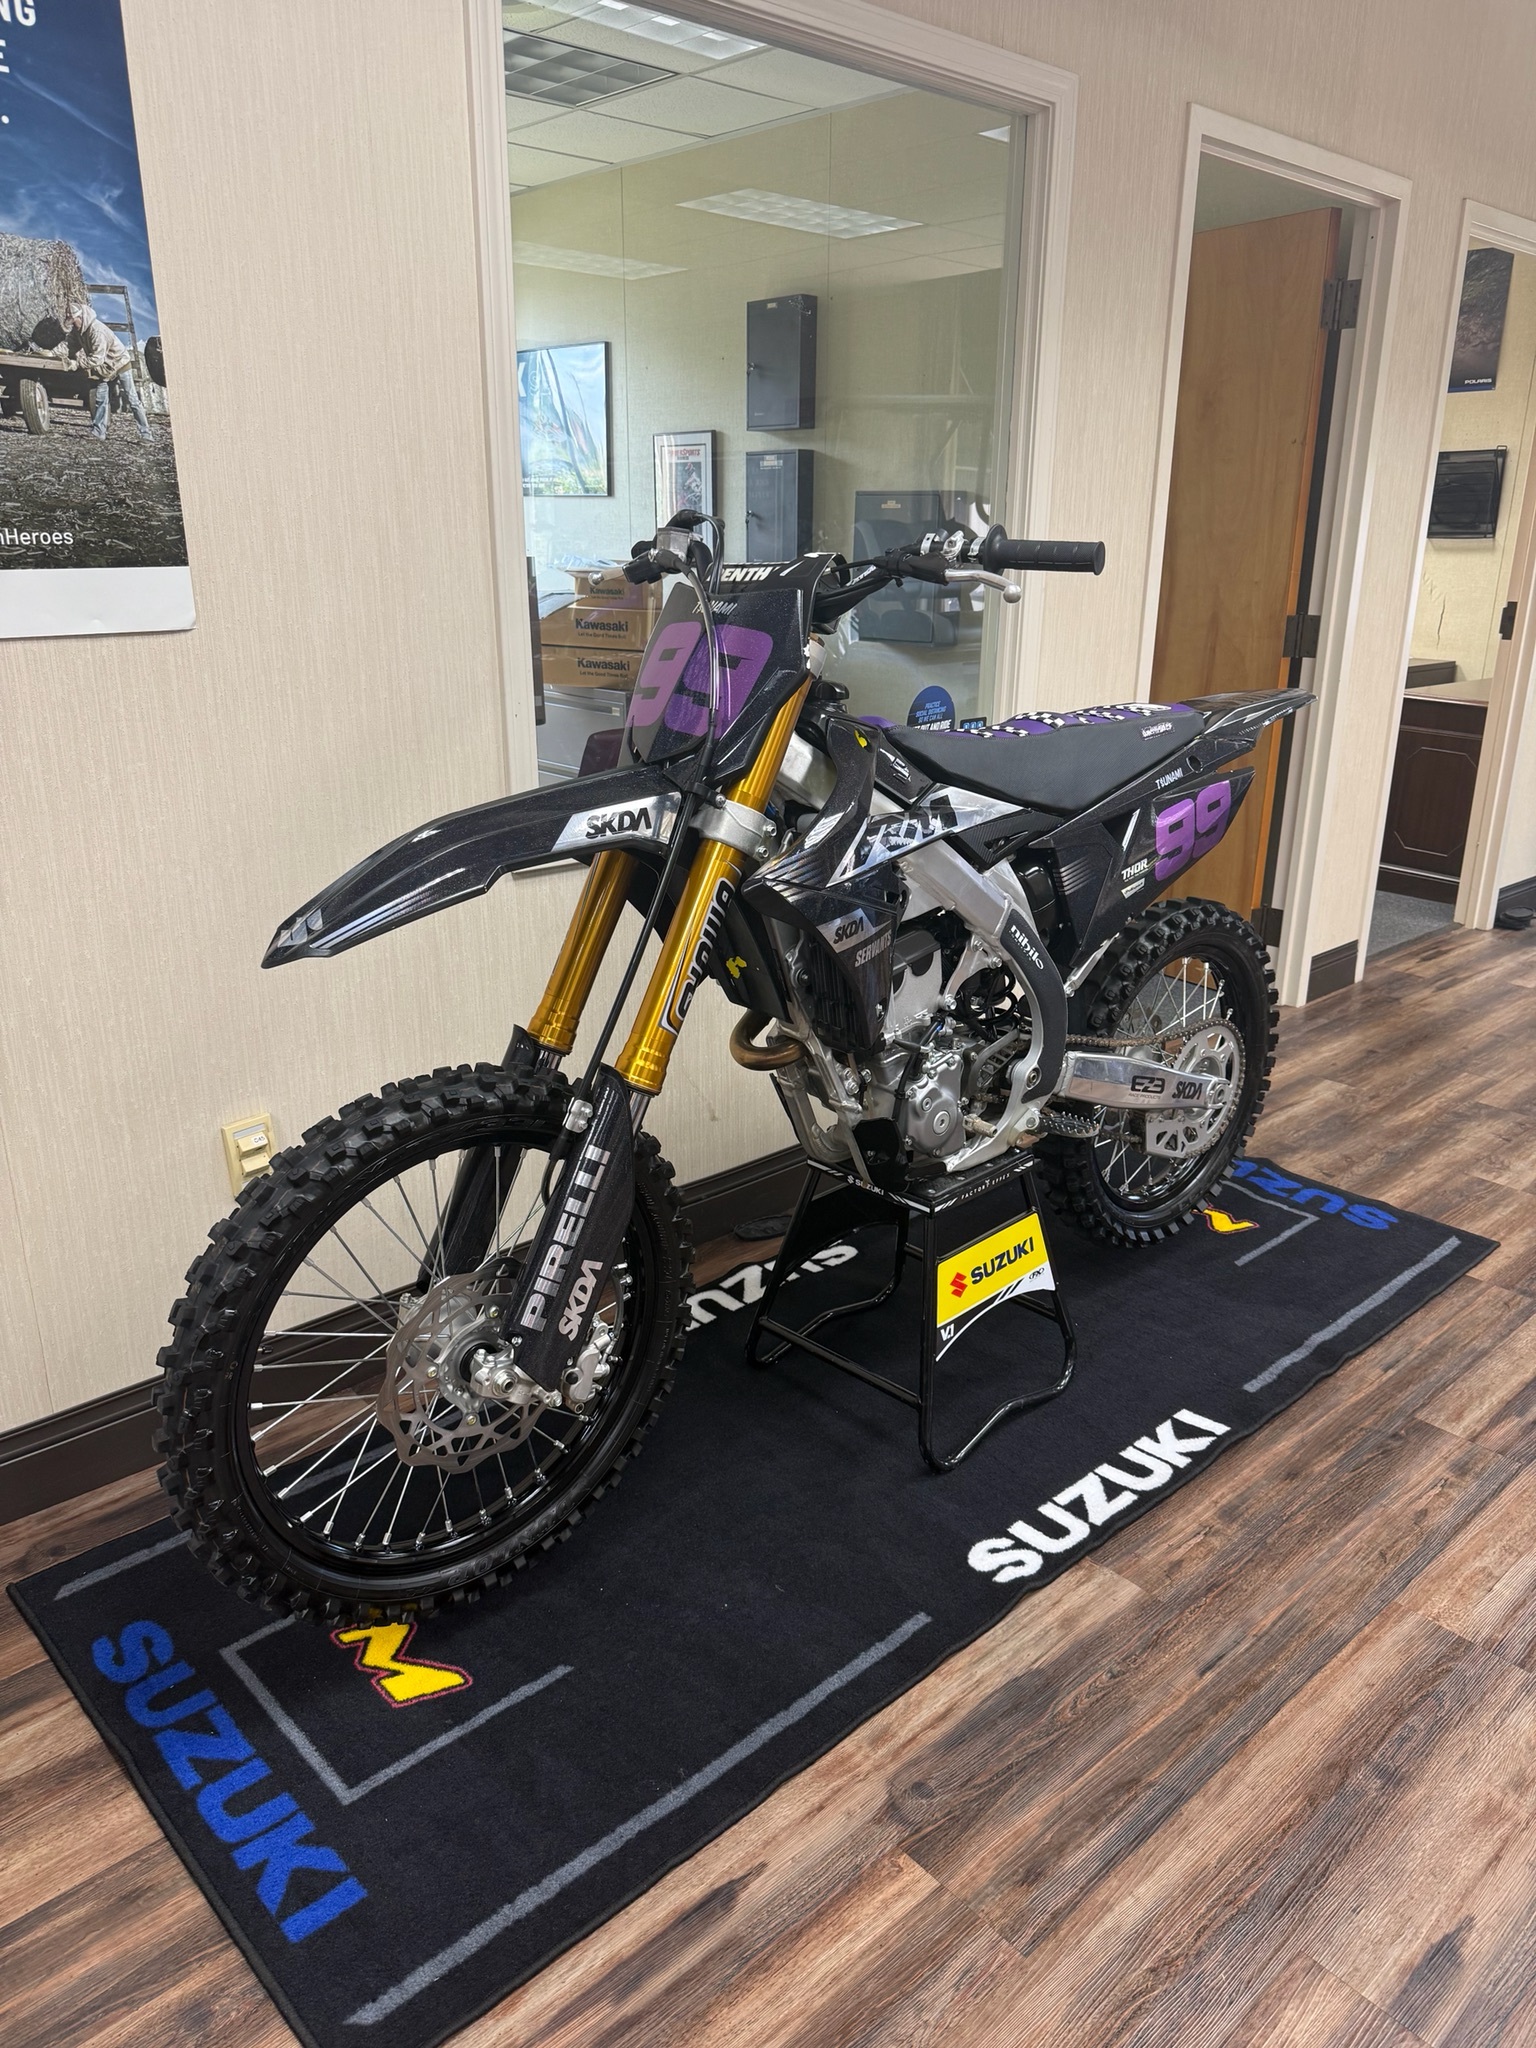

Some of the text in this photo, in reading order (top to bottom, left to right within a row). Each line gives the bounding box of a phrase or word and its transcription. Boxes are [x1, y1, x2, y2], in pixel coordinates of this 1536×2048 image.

[1464, 377, 1493, 385] POLARIS
[590, 587, 625, 596] Kawasaki
[576, 618, 629, 632] Kawasaki
[577, 657, 630, 671] Kawasaki
[940, 719, 952, 730] RIDE
[1155, 768, 1184, 790] TSUNAMI
[585, 807, 652, 839] SKDA
[1155, 780, 1232, 882] 99
[1121, 858, 1148, 880] THOR
[833, 916, 864, 945] SKDA
[855, 931, 892, 968] SERVANTS
[1172, 1081, 1203, 1100] SKDA
[520, 1144, 611, 1332] PIRELLI
[970, 1236, 1035, 1285] SUZUKI
[558, 1258, 604, 1342] SKDA
[967, 1408, 1232, 1584] SUZUKI
[91, 1619, 369, 1944] SUZUKI
